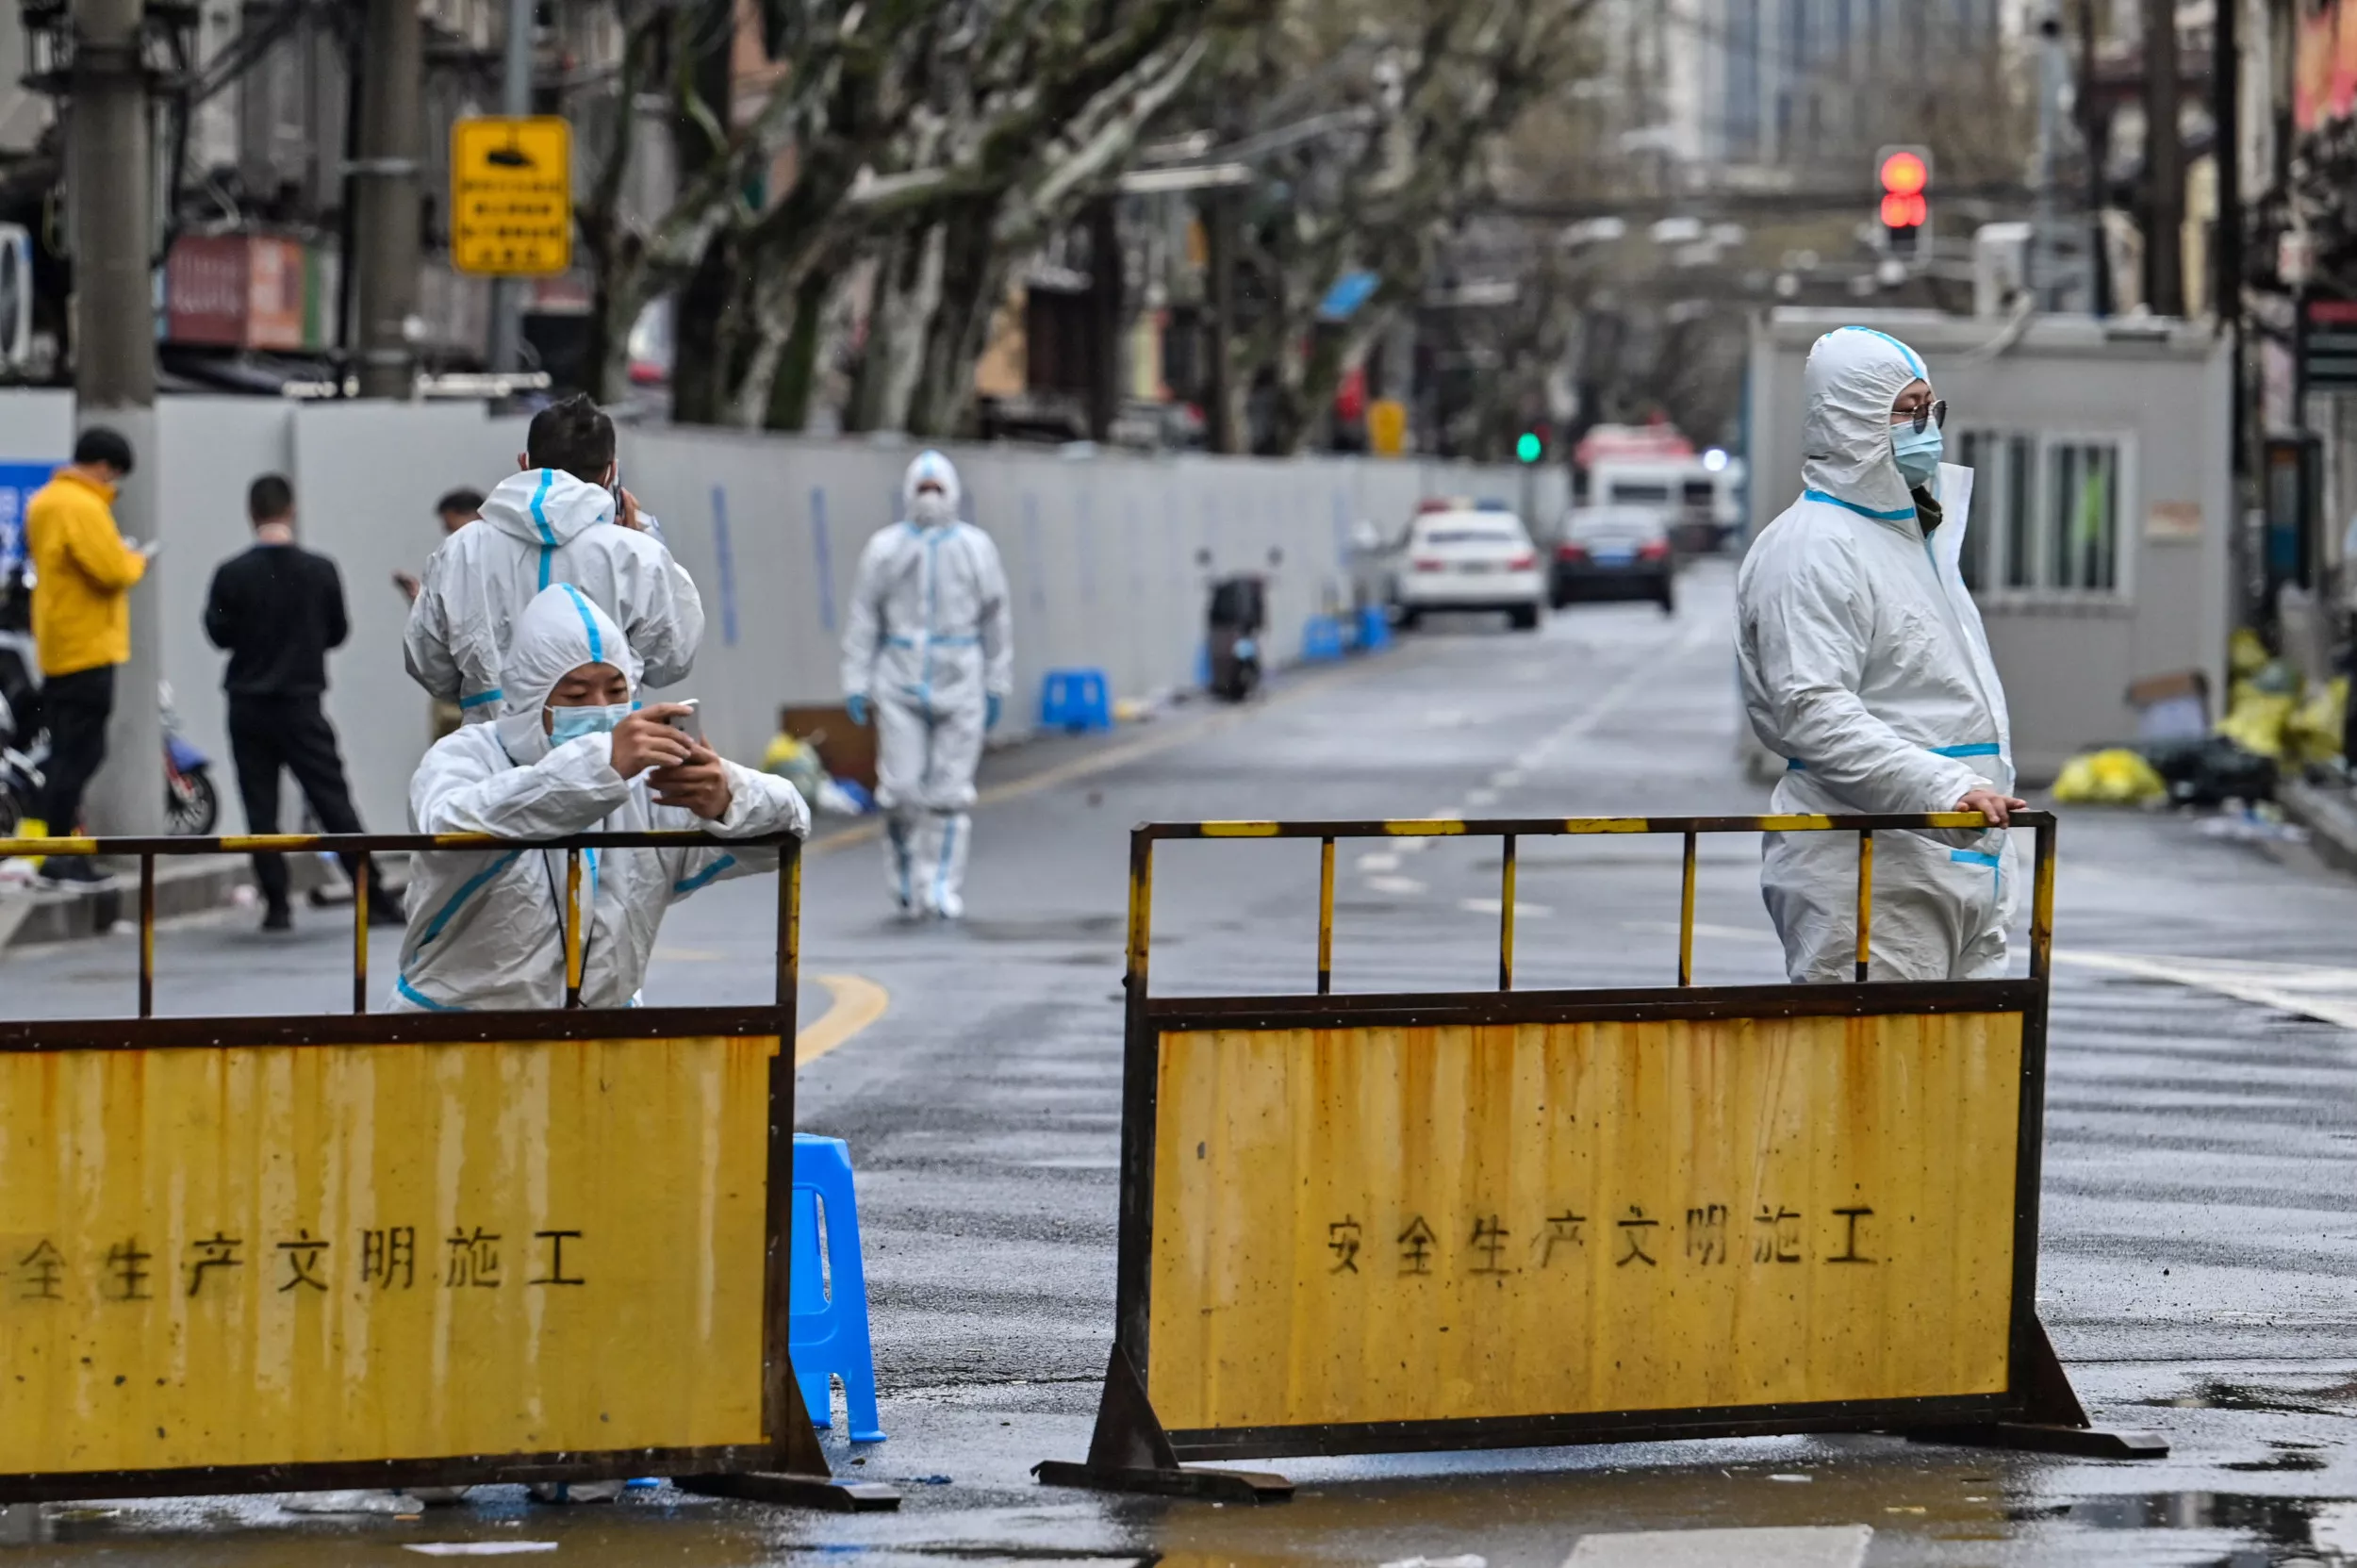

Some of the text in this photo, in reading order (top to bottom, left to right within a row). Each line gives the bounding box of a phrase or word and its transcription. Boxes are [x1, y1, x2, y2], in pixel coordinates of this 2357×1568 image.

[19, 1226, 585, 1301] 全生产文明施工
[1327, 1205, 1877, 1277] 安全生产文明施工
